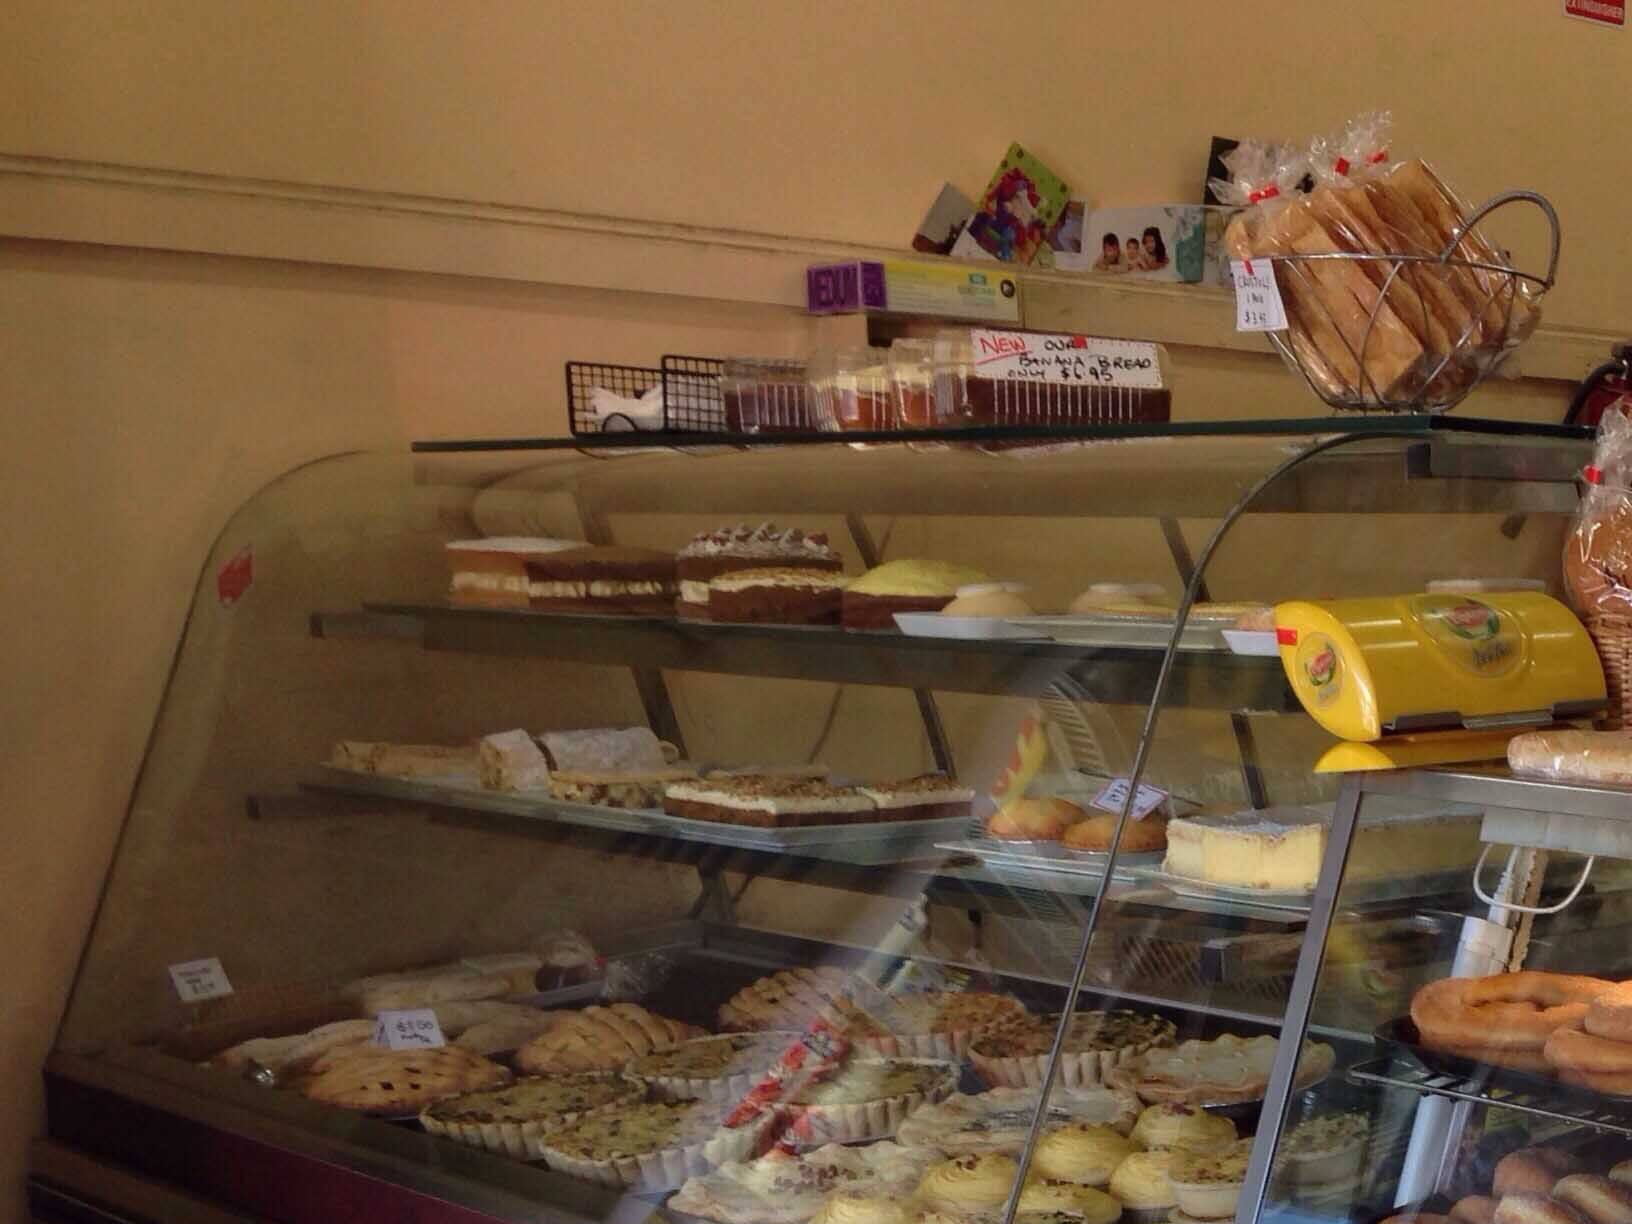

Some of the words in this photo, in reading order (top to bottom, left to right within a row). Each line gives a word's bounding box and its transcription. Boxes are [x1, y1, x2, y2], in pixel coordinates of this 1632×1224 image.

[979, 335, 1027, 354] NEW
[1019, 353, 1085, 367] BANANA
[1097, 355, 1151, 369] BREAD
[1008, 368, 1045, 379] ONLY
[1061, 366, 1113, 382] $6.95
